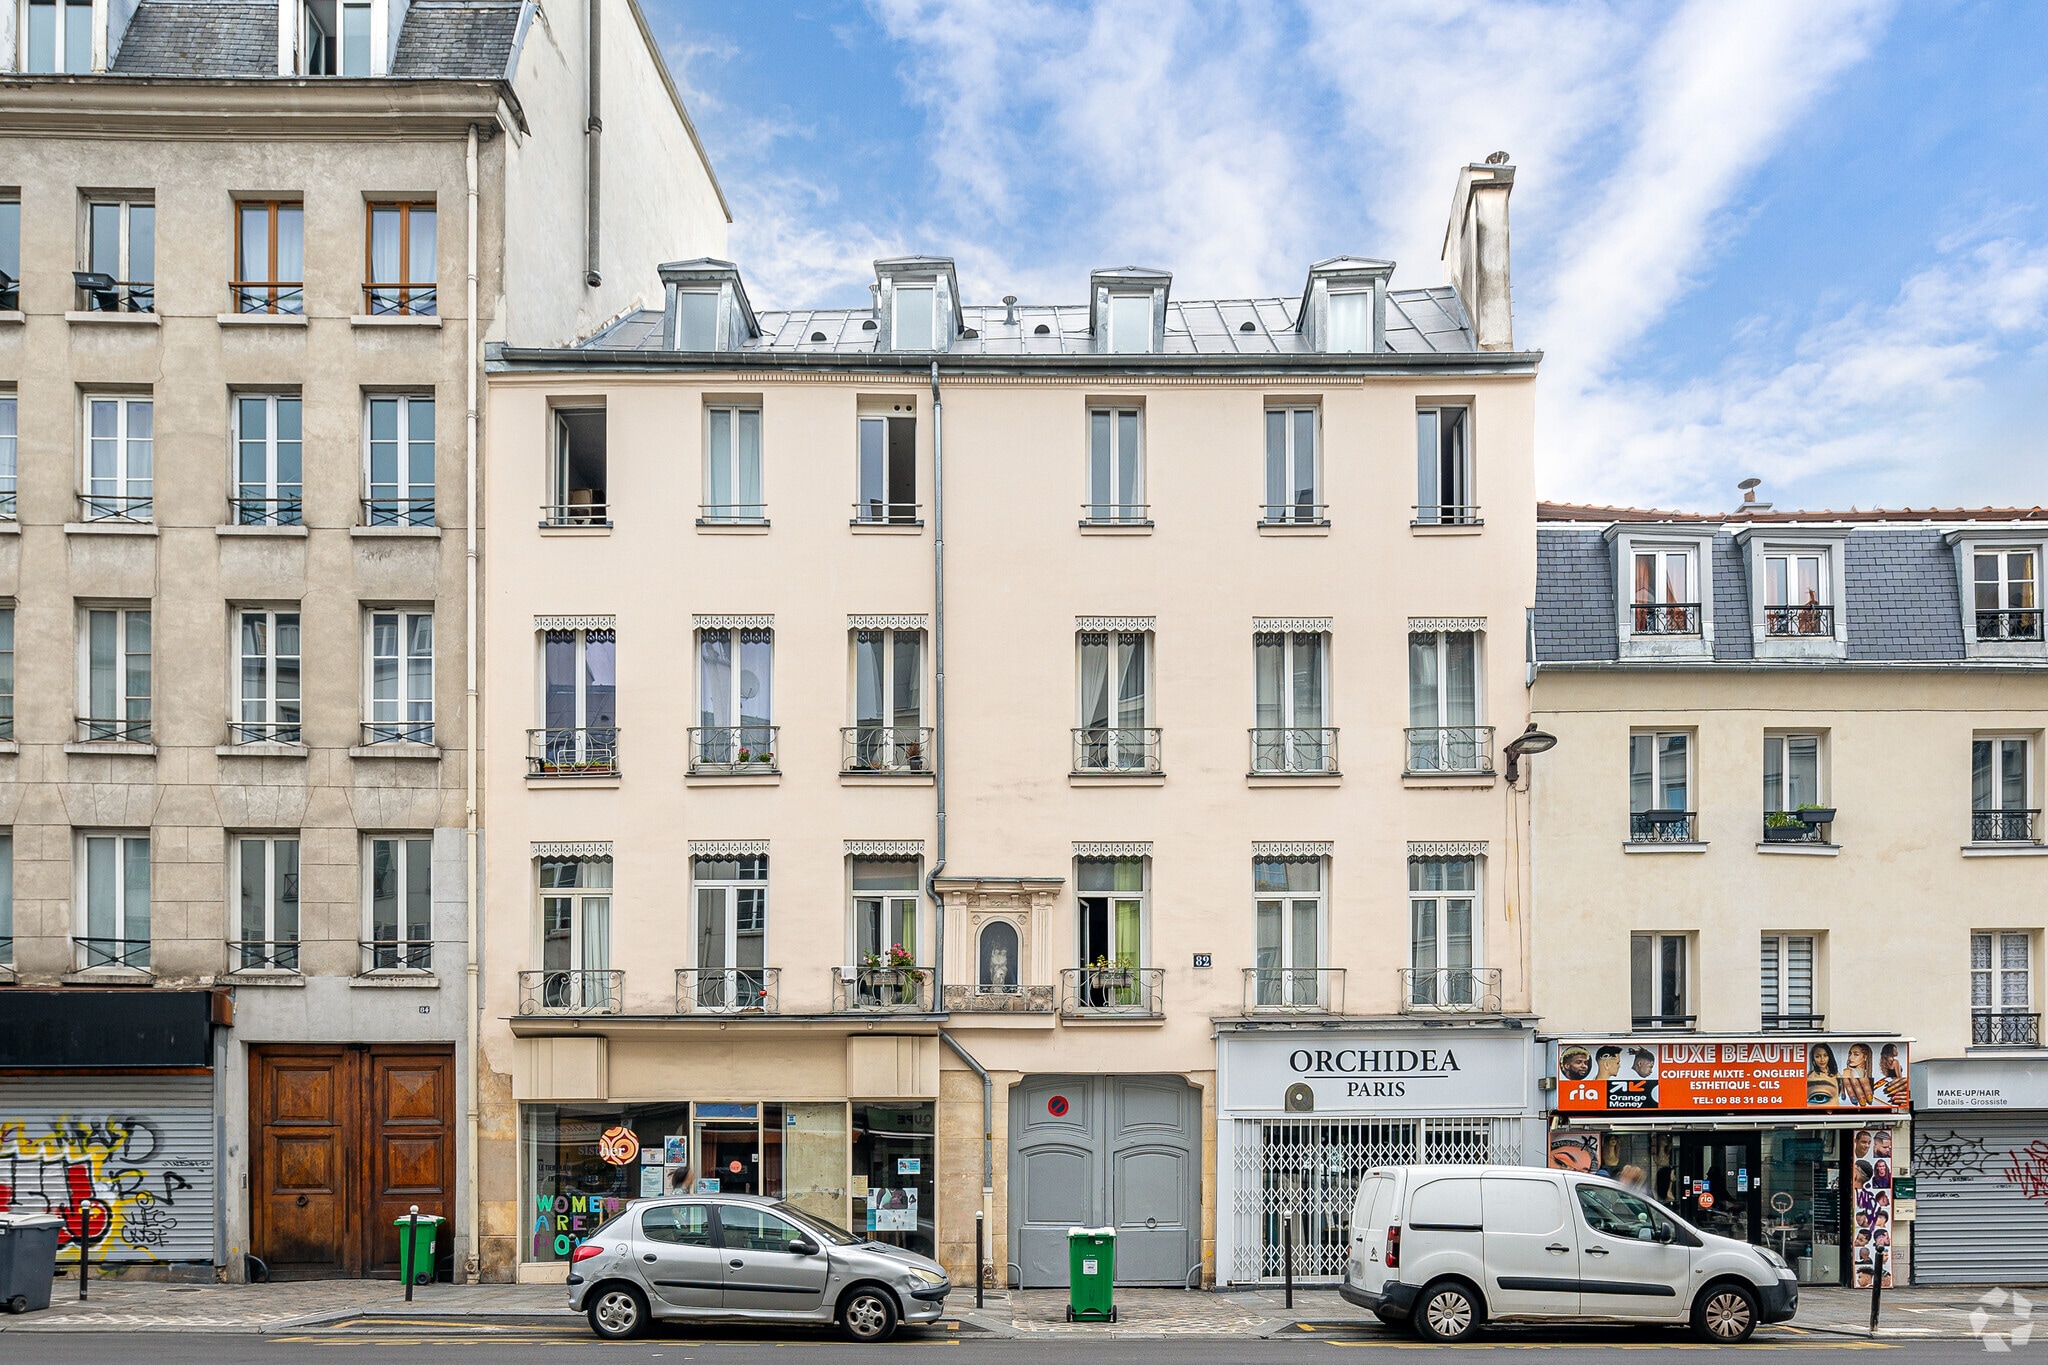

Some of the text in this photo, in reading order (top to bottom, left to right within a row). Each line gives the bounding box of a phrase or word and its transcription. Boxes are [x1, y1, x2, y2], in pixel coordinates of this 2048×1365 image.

[1195, 955, 1210, 967] 82
[419, 1006, 430, 1014] 84
[1661, 1043, 1805, 1064] LUXE BEAUTE
[1289, 1049, 1461, 1072] ORCHIDEA
[1661, 1069, 1710, 1079] COIFFURE
[1713, 1069, 1745, 1079] MIXTE
[1752, 1069, 1805, 1078] ONGLERIE
[1347, 1082, 1406, 1097] PARIS
[1690, 1080, 1751, 1090] ESTHETIQUE
[1758, 1080, 1780, 1090] CILS
[1569, 1083, 1599, 1101] ria
[1937, 1089, 2001, 1097] MAKE-UP/HAIR
[1609, 1094, 1647, 1102] Orange
[1692, 1096, 1783, 1104] TEL: 09 88 31 88 04
[1937, 1098, 1965, 1106] Détails
[1970, 1098, 2008, 1106] Grossiste
[1609, 1101, 1644, 1109] Money
[578, 1142, 625, 1158] sisther
[1700, 1194, 1713, 1202] ria
[535, 1193, 620, 1214] WOMEN
[534, 1215, 588, 1233] ARE
